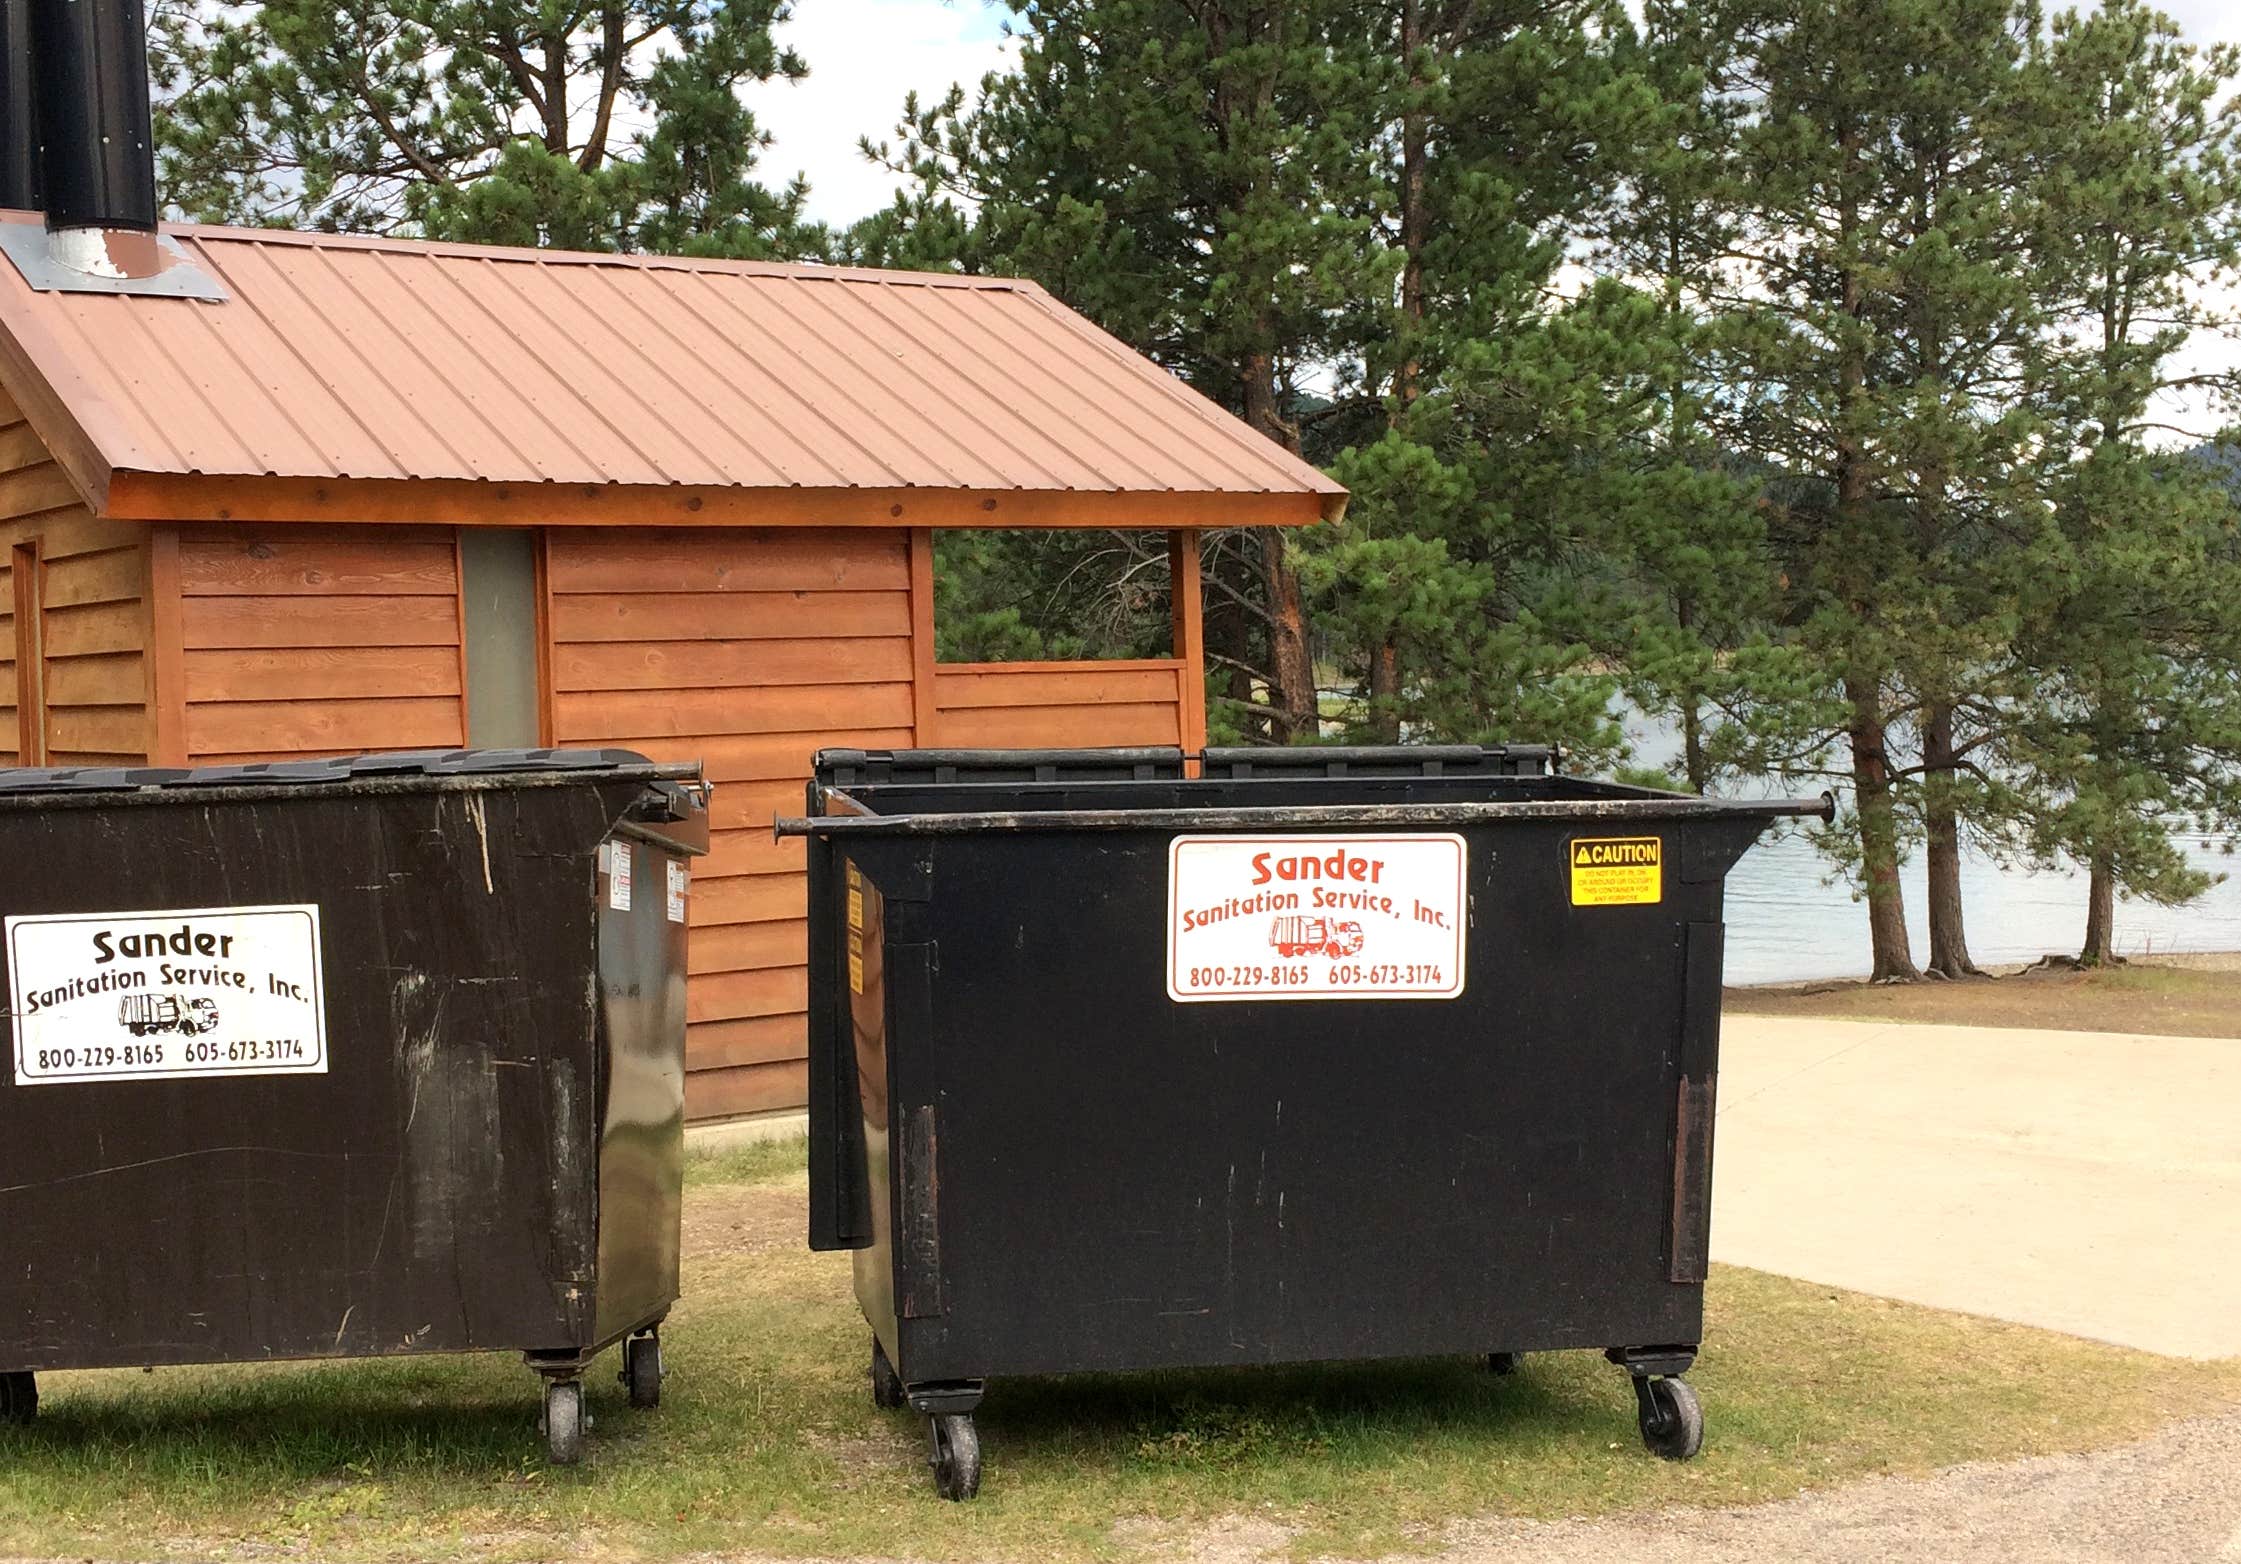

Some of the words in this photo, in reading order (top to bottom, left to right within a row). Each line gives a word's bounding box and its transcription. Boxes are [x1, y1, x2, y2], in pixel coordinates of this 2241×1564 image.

[1252, 849, 1384, 886] Sander
[1592, 844, 1656, 863] CAUTION
[1183, 890, 1299, 933] Sanitation
[1312, 886, 1401, 919] Service,
[1414, 898, 1451, 930] Inc.
[93, 925, 233, 964] Sander
[27, 969, 146, 1014] Sanitation
[159, 963, 255, 994] Service,
[269, 972, 309, 1003] Inc.
[1190, 965, 1309, 987] 800-229-8165
[1328, 964, 1442, 984] 605-673-3174
[39, 1044, 164, 1069] 800-229-8165
[185, 1039, 303, 1062] 605-673-3174
